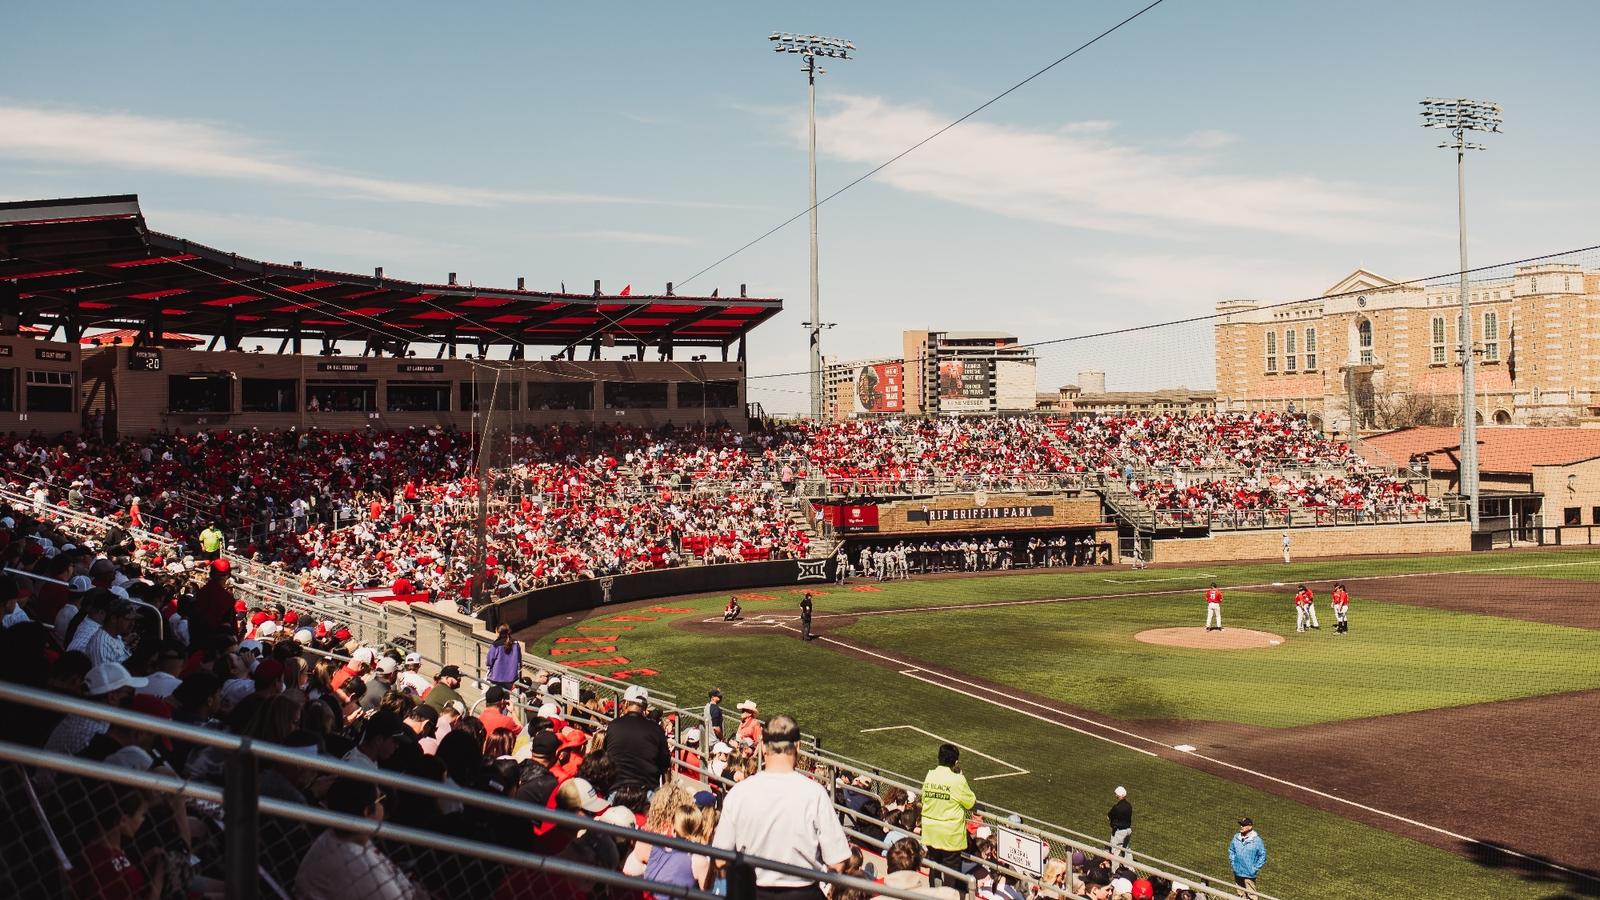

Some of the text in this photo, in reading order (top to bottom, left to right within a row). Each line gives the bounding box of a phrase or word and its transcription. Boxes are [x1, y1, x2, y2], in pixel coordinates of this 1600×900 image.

[930, 506, 1033, 521] RIP GRIFFIN PARK
